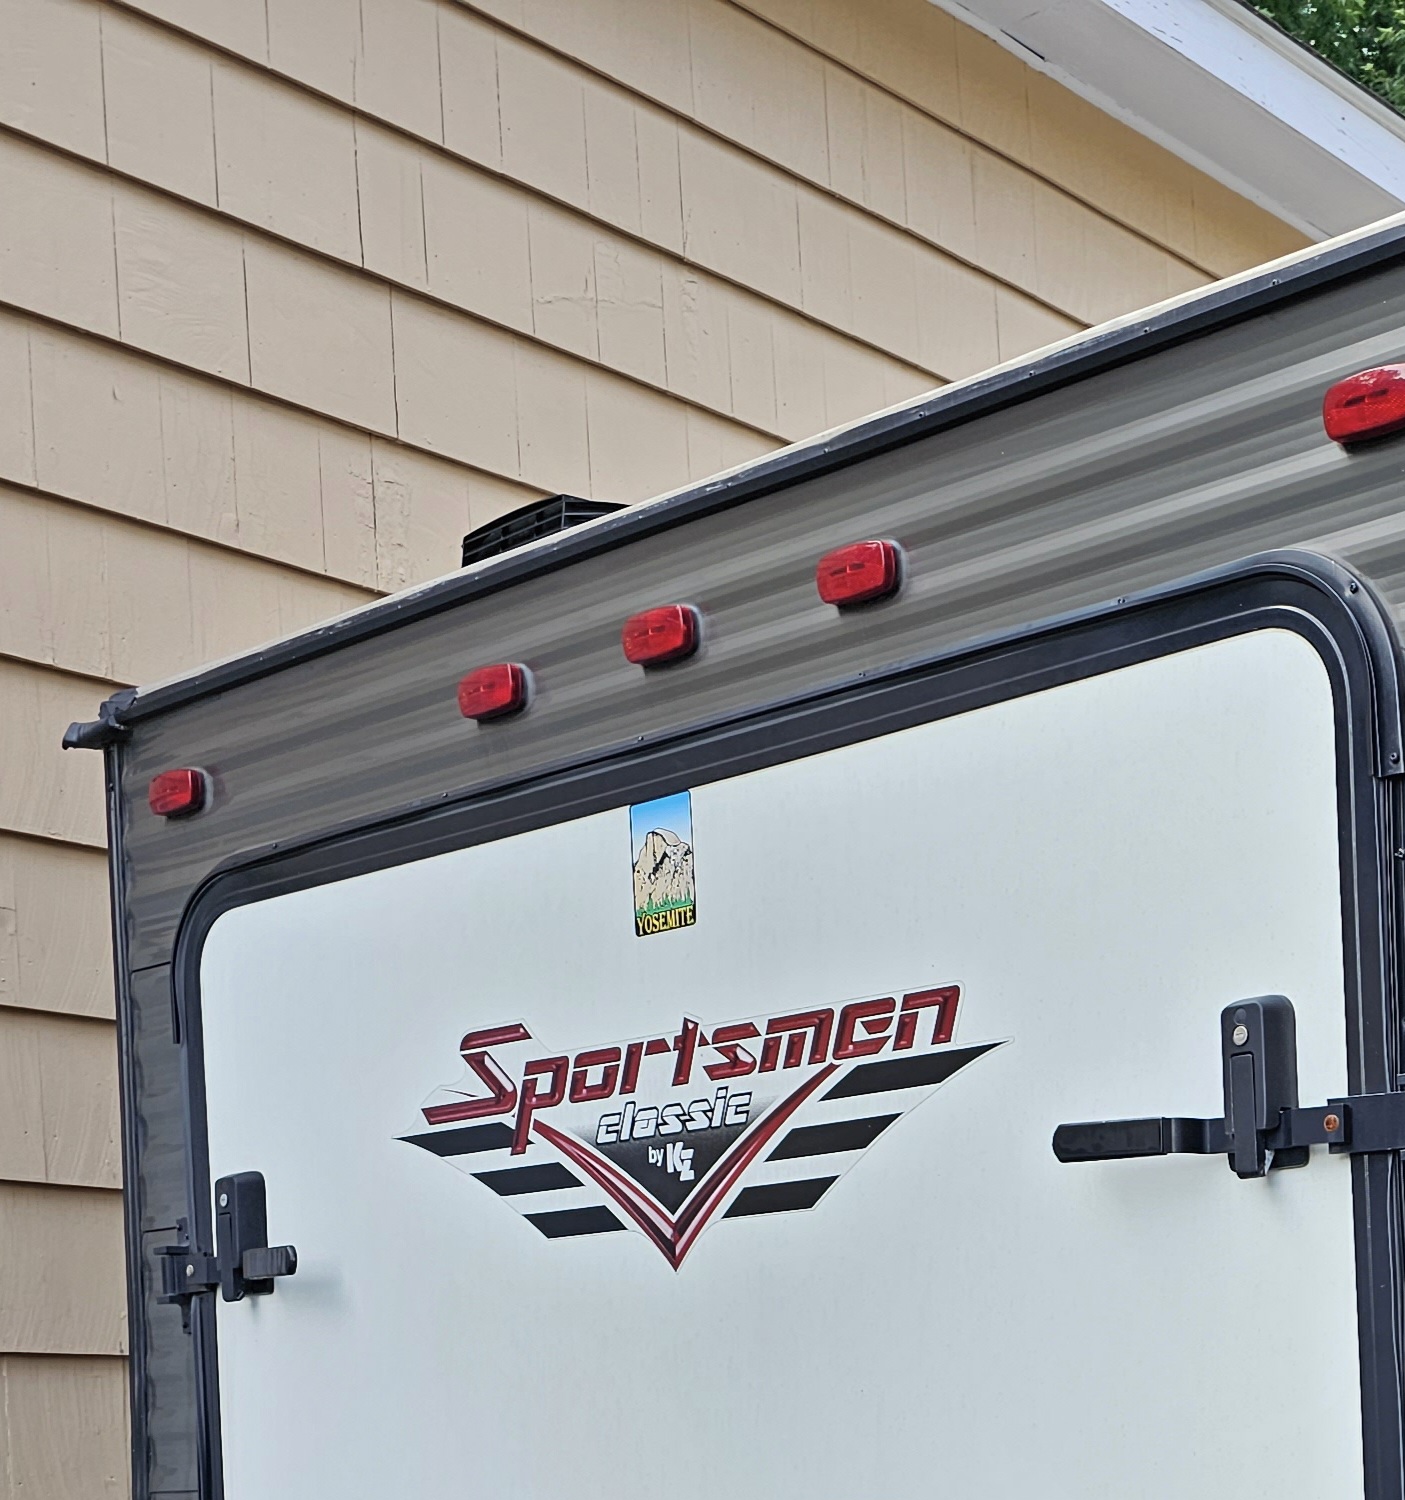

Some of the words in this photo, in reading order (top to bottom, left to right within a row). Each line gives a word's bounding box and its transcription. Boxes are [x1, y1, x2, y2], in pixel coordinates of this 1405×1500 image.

[636, 905, 695, 936] YOSEMITE
[421, 985, 961, 1156] Sportsmen
[595, 1085, 753, 1146] classic
[648, 1145, 665, 1167] by
